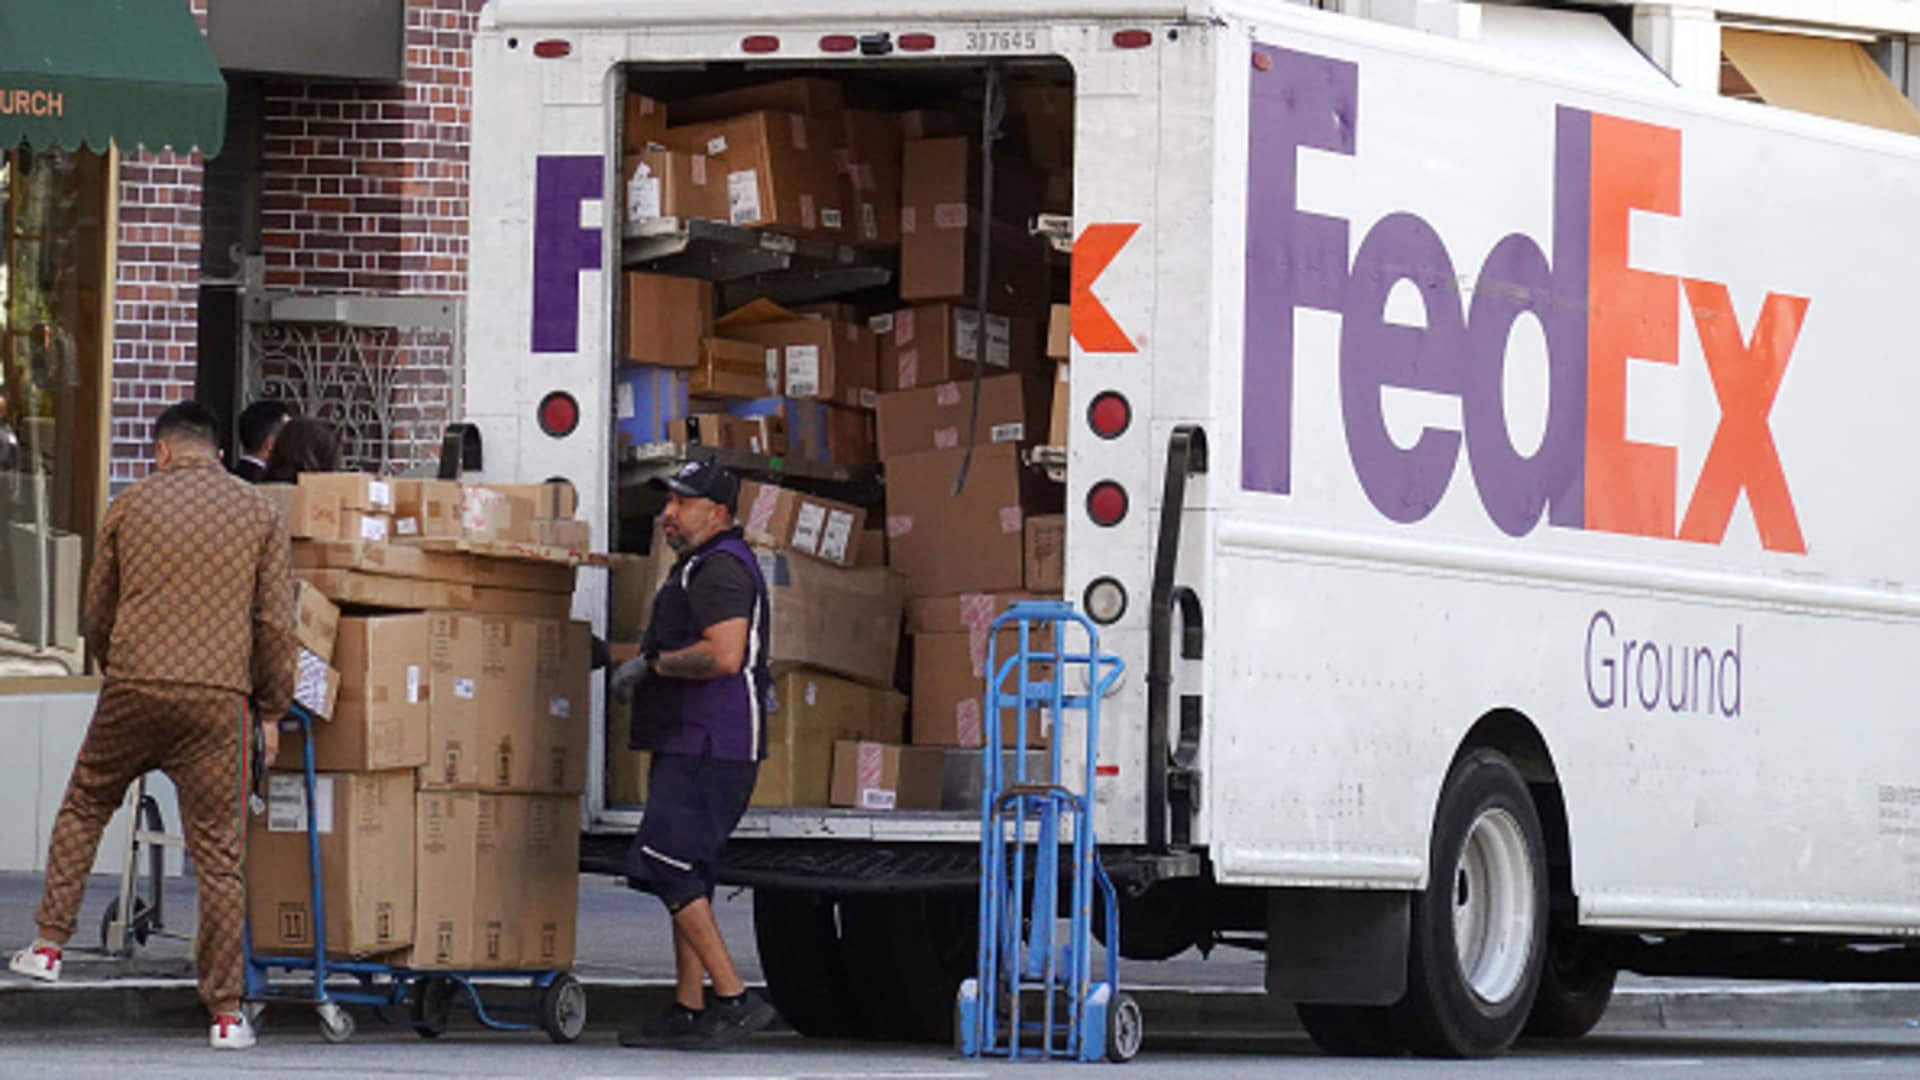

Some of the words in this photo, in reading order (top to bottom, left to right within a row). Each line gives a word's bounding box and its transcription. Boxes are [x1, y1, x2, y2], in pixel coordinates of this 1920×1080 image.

[0, 89, 63, 118] URCH
[1241, 41, 1810, 555] FedEx
[1584, 610, 1743, 718] Ground
